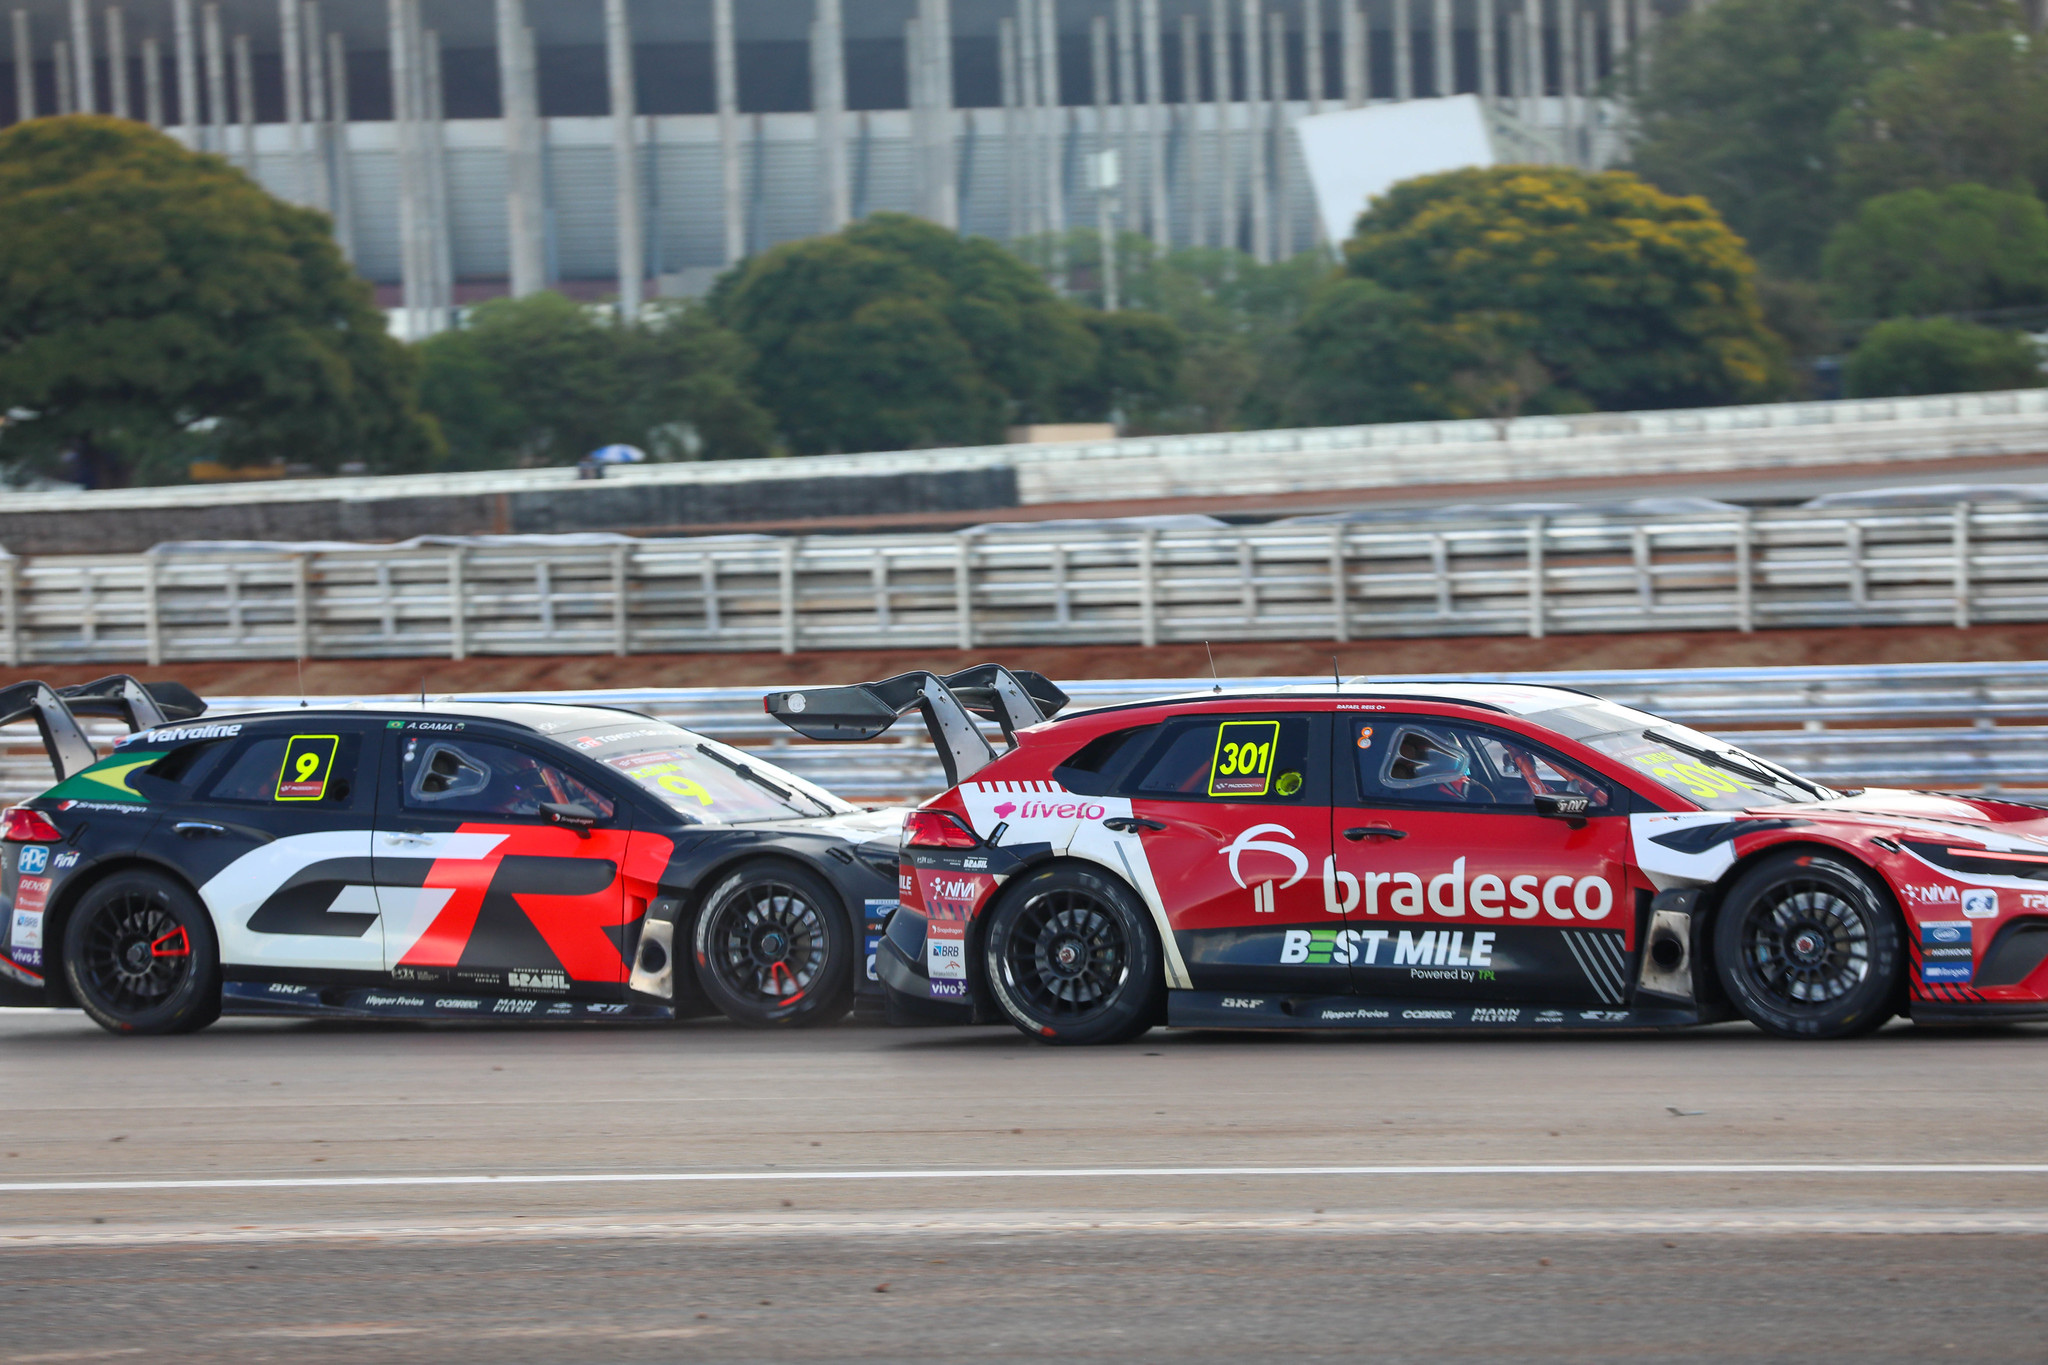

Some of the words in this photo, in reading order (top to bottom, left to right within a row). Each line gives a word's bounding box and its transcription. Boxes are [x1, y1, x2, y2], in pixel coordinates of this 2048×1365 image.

[147, 724, 242, 743] Valvoline
[1219, 742, 1270, 775] 301
[295, 752, 320, 783] 9
[1652, 760, 1754, 798] 301
[657, 775, 714, 806] 9
[75, 801, 148, 815] Snapdragon
[1020, 800, 1105, 820] livelo
[20, 848, 46, 870] PPG
[20, 879, 50, 892] DENSO
[1323, 853, 1613, 921] bradesco
[942, 946, 959, 957] BRB
[1279, 929, 1389, 964] BEST
[1393, 930, 1496, 966] MILE
[508, 972, 571, 990] BRASIL
[1410, 968, 1458, 979] Powered
[1461, 968, 1475, 982] by
[931, 981, 957, 994] vivo
[365, 995, 400, 1006] Hipper
[400, 996, 425, 1006] Freios
[496, 998, 537, 1007] MANN
[1321, 1010, 1357, 1020] Hipper
[1357, 1009, 1390, 1018] Freios
[1471, 1015, 1518, 1023] FILTER
[1474, 1008, 1521, 1017] MANN
